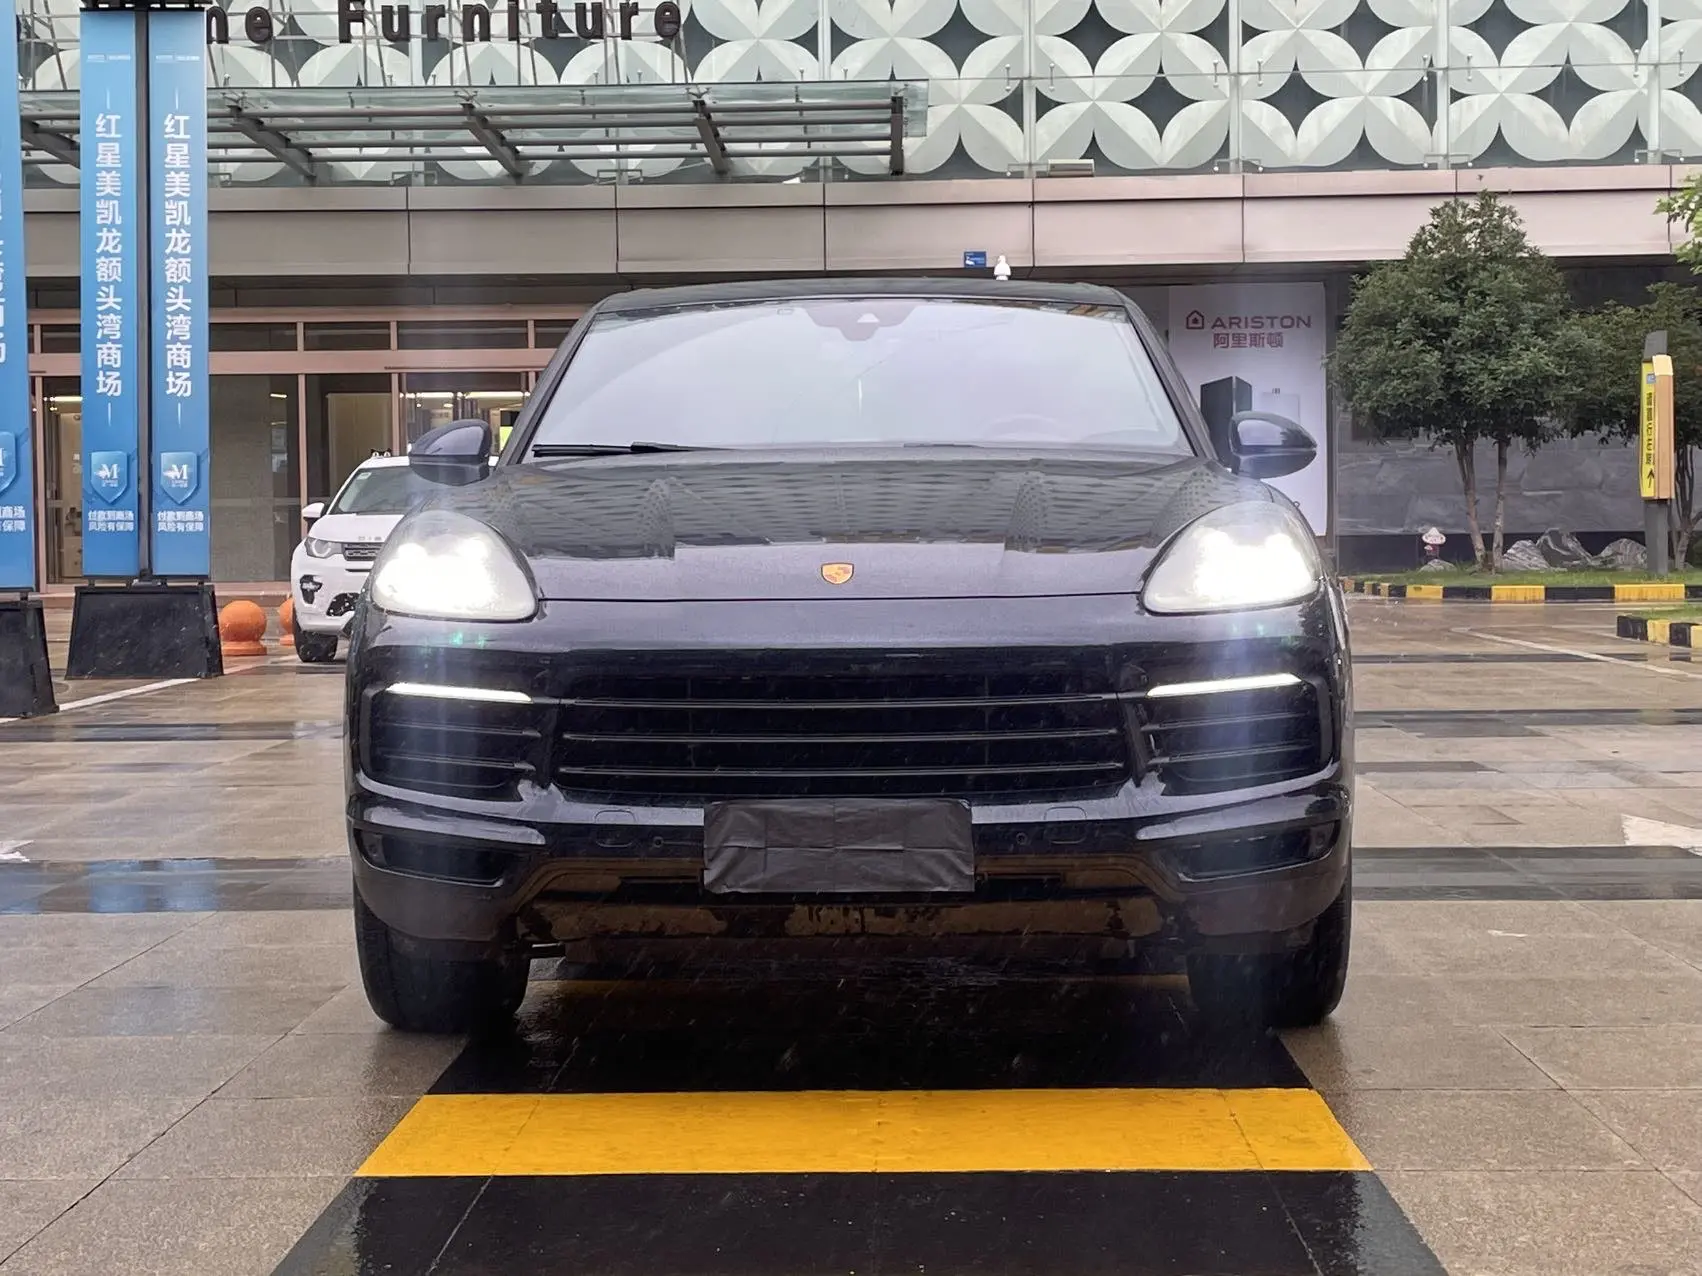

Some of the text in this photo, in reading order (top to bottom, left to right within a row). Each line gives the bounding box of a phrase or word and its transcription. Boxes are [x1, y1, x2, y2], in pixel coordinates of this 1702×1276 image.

[338, 0, 681, 43] Furniture
[95, 113, 123, 396] 红星美凯龙额头湾商场
[163, 113, 192, 397] 红星美凯龙额头湾商场
[1211, 315, 1312, 329] ARISTON
[1213, 332, 1284, 349] 阿里斯顿
